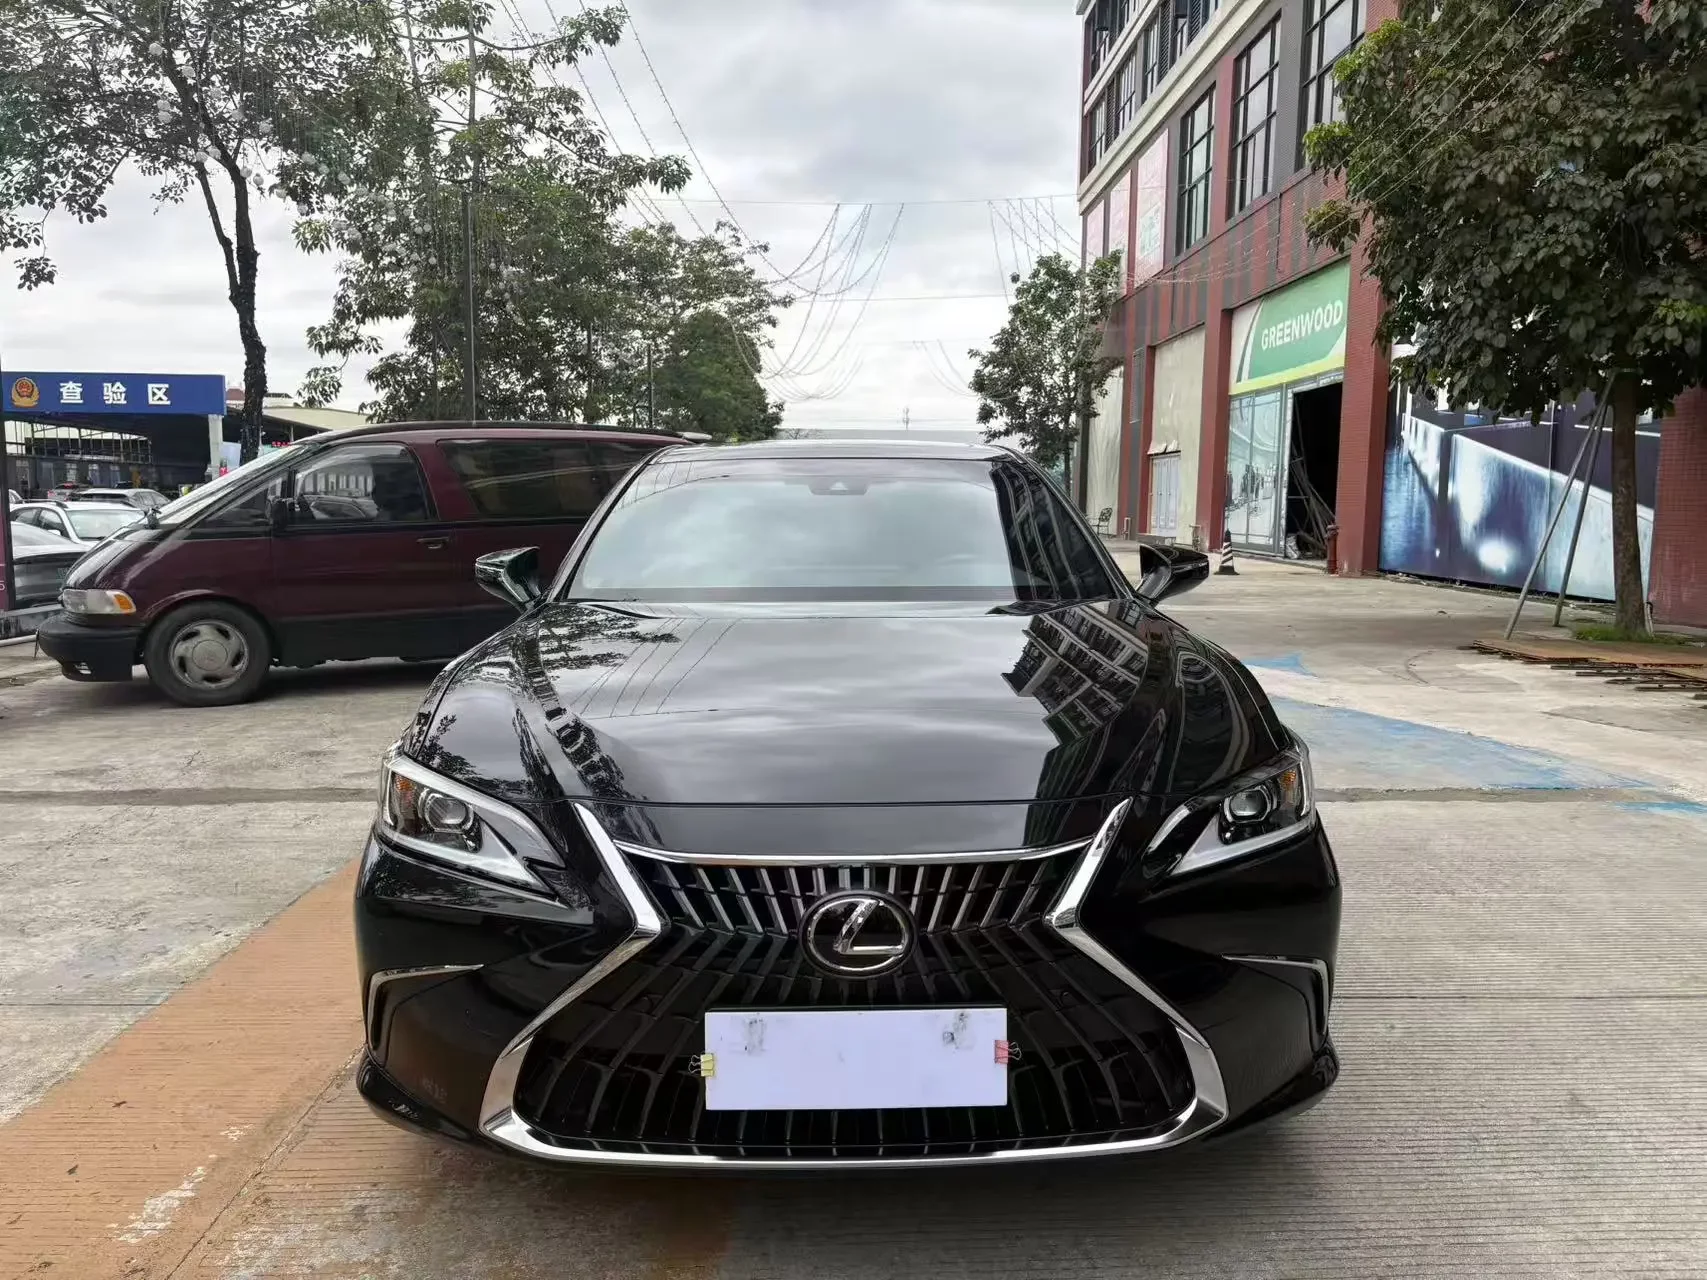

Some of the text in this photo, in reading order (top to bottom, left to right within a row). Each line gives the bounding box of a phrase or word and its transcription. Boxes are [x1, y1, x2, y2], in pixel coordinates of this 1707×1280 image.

[1261, 300, 1343, 351] GREENWOOD
[59, 381, 171, 405] 查验区
